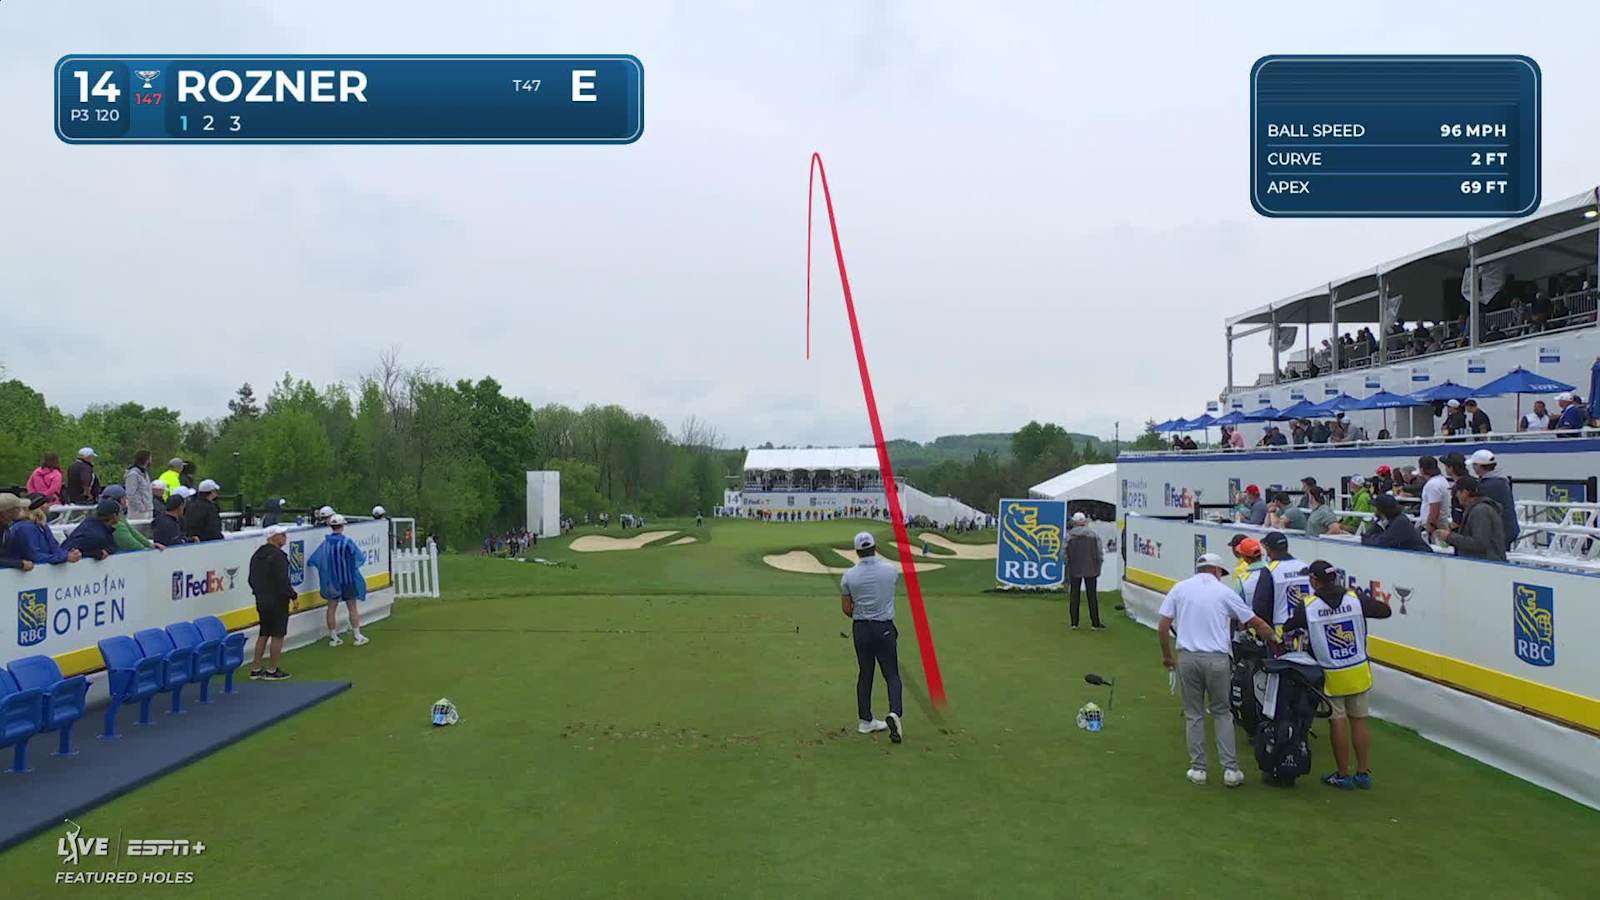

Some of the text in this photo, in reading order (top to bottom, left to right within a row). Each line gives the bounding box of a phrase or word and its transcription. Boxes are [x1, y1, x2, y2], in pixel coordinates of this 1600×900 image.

[727, 494, 739, 505] 14
[1128, 492, 1148, 508] OPEN
[1171, 487, 1193, 508] FedEx
[1138, 537, 1156, 558] FedEx
[1004, 560, 1058, 580] RBC
[54, 574, 126, 601] CANADIAN
[186, 570, 225, 598] FedEx
[52, 597, 126, 635] OPEN
[1318, 604, 1353, 618] COVELLO
[19, 626, 46, 645] RBC
[1331, 644, 1356, 660] RBC
[1518, 639, 1553, 664] RBC
